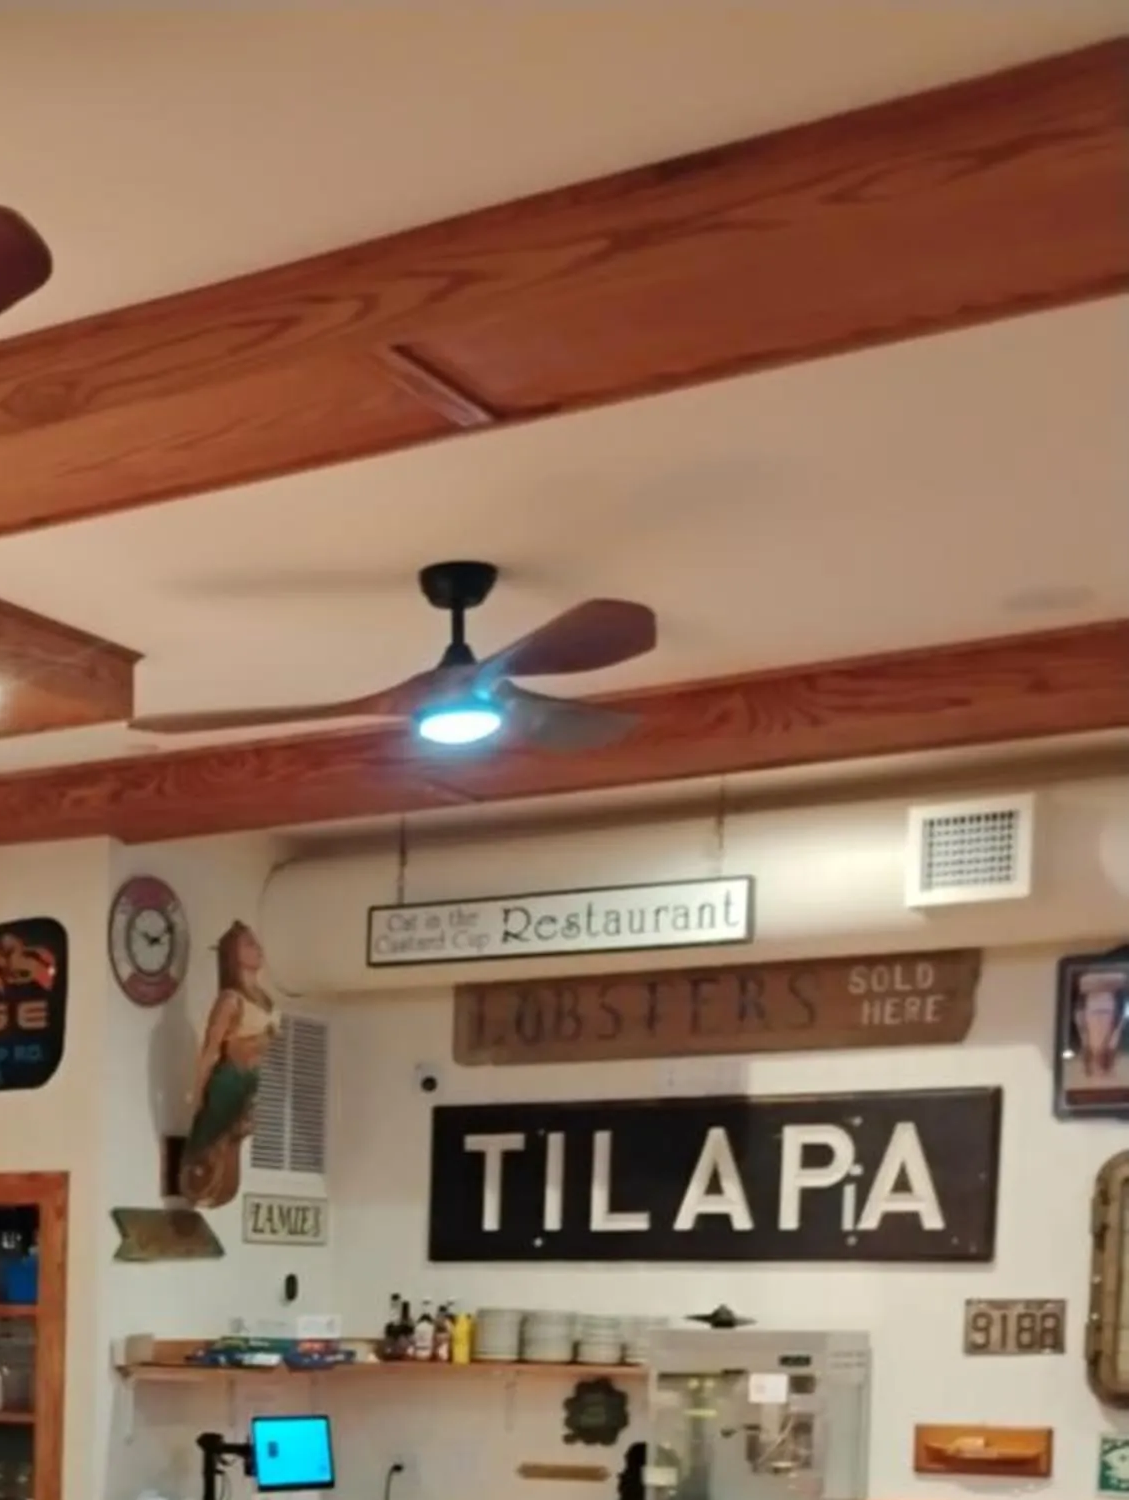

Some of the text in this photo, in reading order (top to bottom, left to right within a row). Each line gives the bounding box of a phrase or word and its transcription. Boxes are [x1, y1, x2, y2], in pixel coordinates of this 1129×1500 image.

[501, 889, 740, 944] Restaurant
[848, 963, 934, 993] SOLD
[473, 968, 820, 1046] LOBSTERS
[861, 994, 942, 1026] HERE
